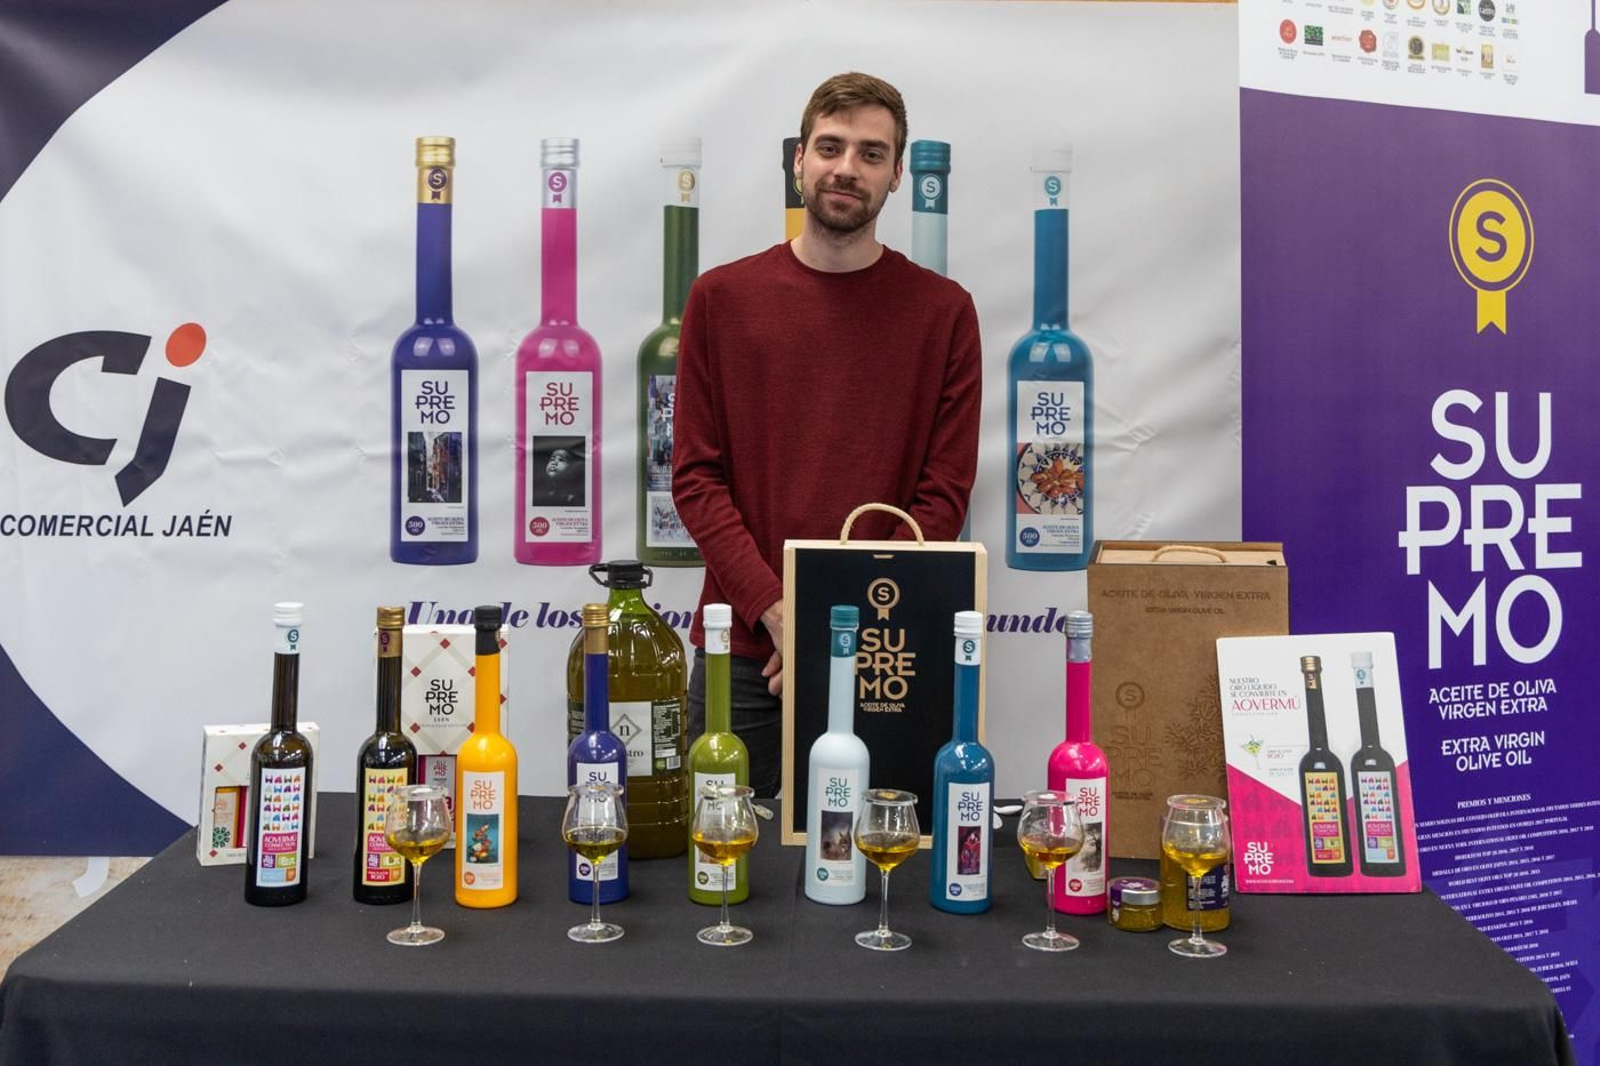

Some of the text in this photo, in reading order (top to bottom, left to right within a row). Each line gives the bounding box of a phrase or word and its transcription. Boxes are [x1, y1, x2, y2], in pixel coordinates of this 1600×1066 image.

[433, 174, 442, 184] S
[554, 176, 562, 187] S
[1048, 180, 1057, 191] S
[926, 181, 936, 192] S
[1476, 211, 1507, 262] S
[422, 380, 448, 395] SU
[546, 382, 572, 397] SU
[415, 395, 456, 410] PRE
[540, 397, 579, 411] PRE
[1038, 392, 1064, 406] SU
[420, 410, 450, 424] MO
[545, 411, 575, 426] MO
[1031, 407, 1070, 421] PRE
[1036, 421, 1066, 436] MO
[1430, 389, 1552, 480] SU
[0, 509, 232, 537] COMERCIAL JAÉN
[1398, 483, 1583, 575] PRE
[1022, 531, 1037, 539] 500
[878, 587, 889, 601] S
[1236, 591, 1271, 601] EXTRA
[536, 602, 584, 628] los
[986, 607, 1066, 633] undo
[1428, 574, 1563, 670] MO
[290, 631, 297, 640] S
[861, 628, 906, 652] SU
[966, 642, 973, 650] S
[854, 652, 916, 676] PRE
[431, 679, 453, 691] SU
[859, 676, 908, 700] MO
[1429, 678, 1557, 704] ACEITE DE OLIVA
[425, 691, 458, 703] PRE
[1232, 695, 1300, 712] AOVERMÚ
[429, 704, 454, 715] MO
[1438, 697, 1548, 720] VIRGEN EXTRA
[1441, 730, 1545, 756] EXTRA VIRGIN
[1456, 750, 1532, 772] OLIVE OIL
[589, 772, 607, 782] SU
[829, 777, 847, 787] SU
[474, 780, 492, 790] SU
[470, 789, 496, 800] PRE
[825, 787, 851, 798] PRE
[962, 792, 980, 801] SU
[1080, 787, 1097, 797] SU
[473, 800, 493, 810] MO
[828, 798, 848, 807] MO
[958, 802, 983, 812] PRE
[1458, 799, 1486, 809] PREMIOS
[1494, 793, 1531, 804] MENCIONES
[961, 812, 980, 821] MO
[1080, 807, 1098, 816] MO
[1247, 841, 1268, 853] SU
[1243, 853, 1274, 865] PRE
[1248, 864, 1271, 875] MO
